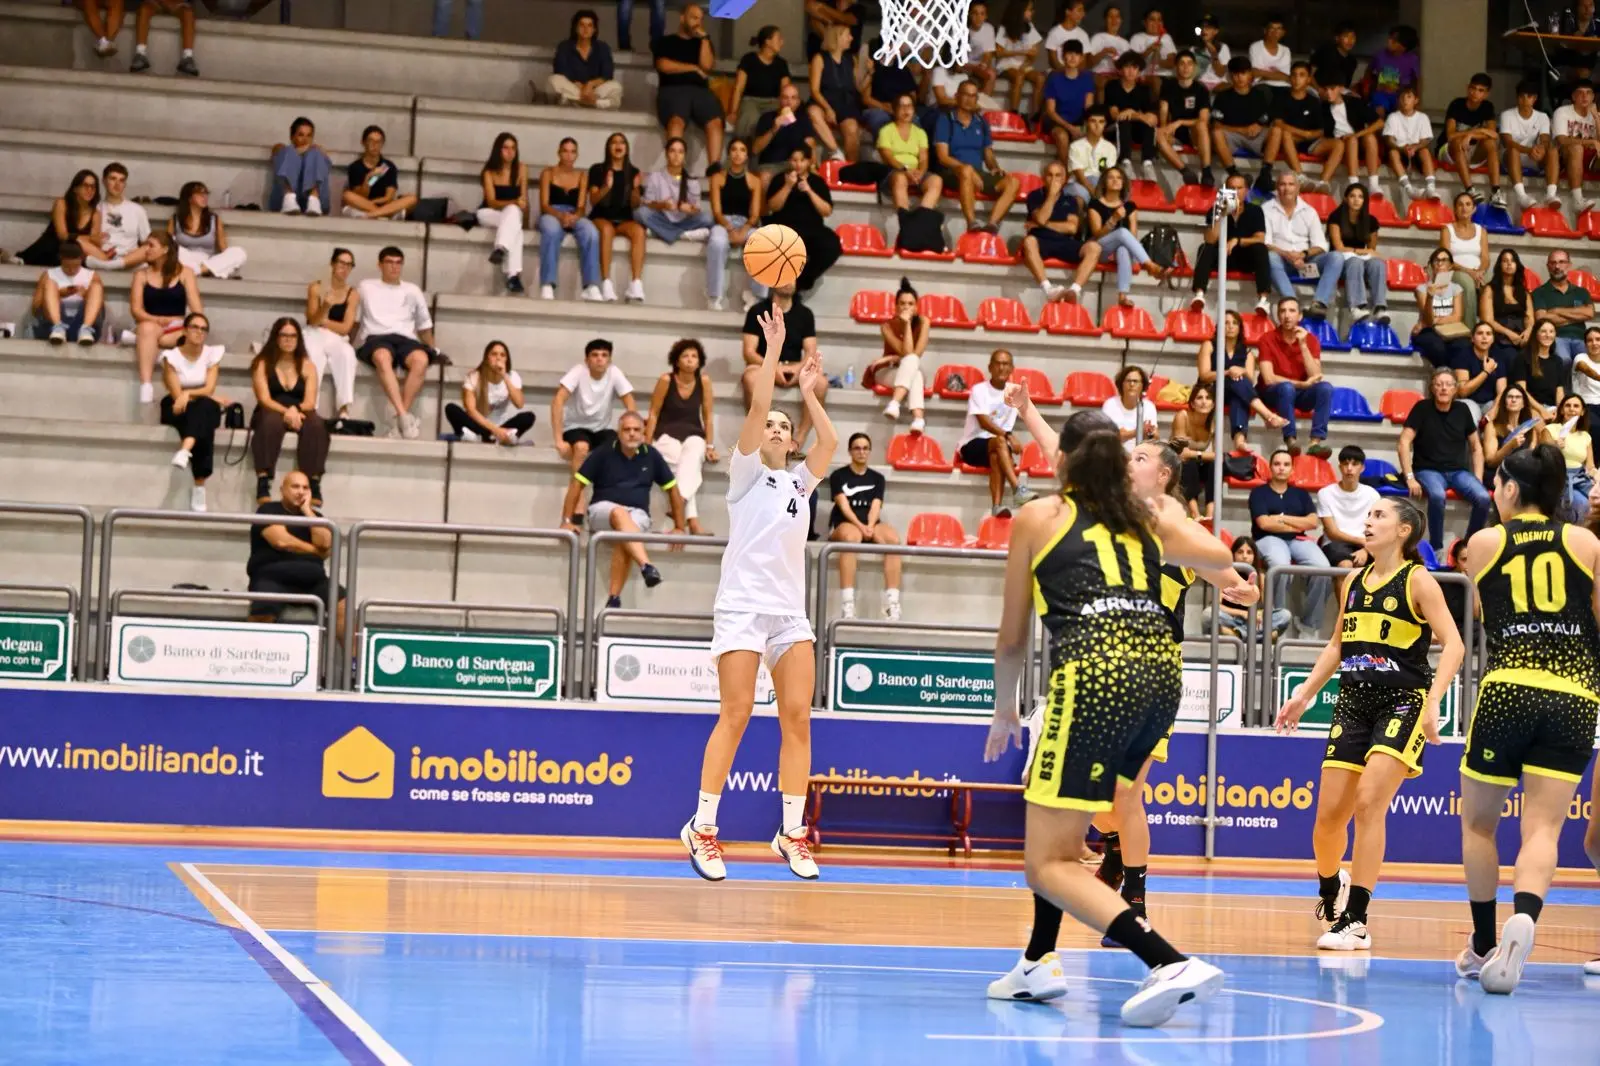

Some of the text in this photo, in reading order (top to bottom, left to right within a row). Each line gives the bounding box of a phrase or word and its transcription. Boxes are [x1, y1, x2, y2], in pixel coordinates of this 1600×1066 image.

[786, 498, 798, 518] 4
[1082, 523, 1149, 591] 11
[1501, 551, 1567, 613] 10
[1380, 619, 1392, 640] 8
[1501, 622, 1582, 639] AEROITALIA
[12, 656, 29, 666] con
[163, 644, 290, 662] Banco di Sardegna
[412, 653, 535, 673] Banco di Sardegna
[456, 672, 476, 685] Ogni
[477, 673, 505, 685] giorno
[507, 675, 522, 685] con
[647, 663, 687, 676] Banco
[690, 665, 702, 677] di
[878, 672, 995, 692] Banco di Sardegna
[920, 690, 939, 702] Ogni
[940, 691, 966, 703] giorno
[967, 693, 982, 702] con
[1385, 718, 1402, 738] 8
[410, 746, 633, 786] imobiliando
[1039, 750, 1056, 780] BSS
[410, 788, 593, 805] come se fosse casa nostra
[1147, 813, 1163, 825] se
[1236, 816, 1278, 828] nostra
